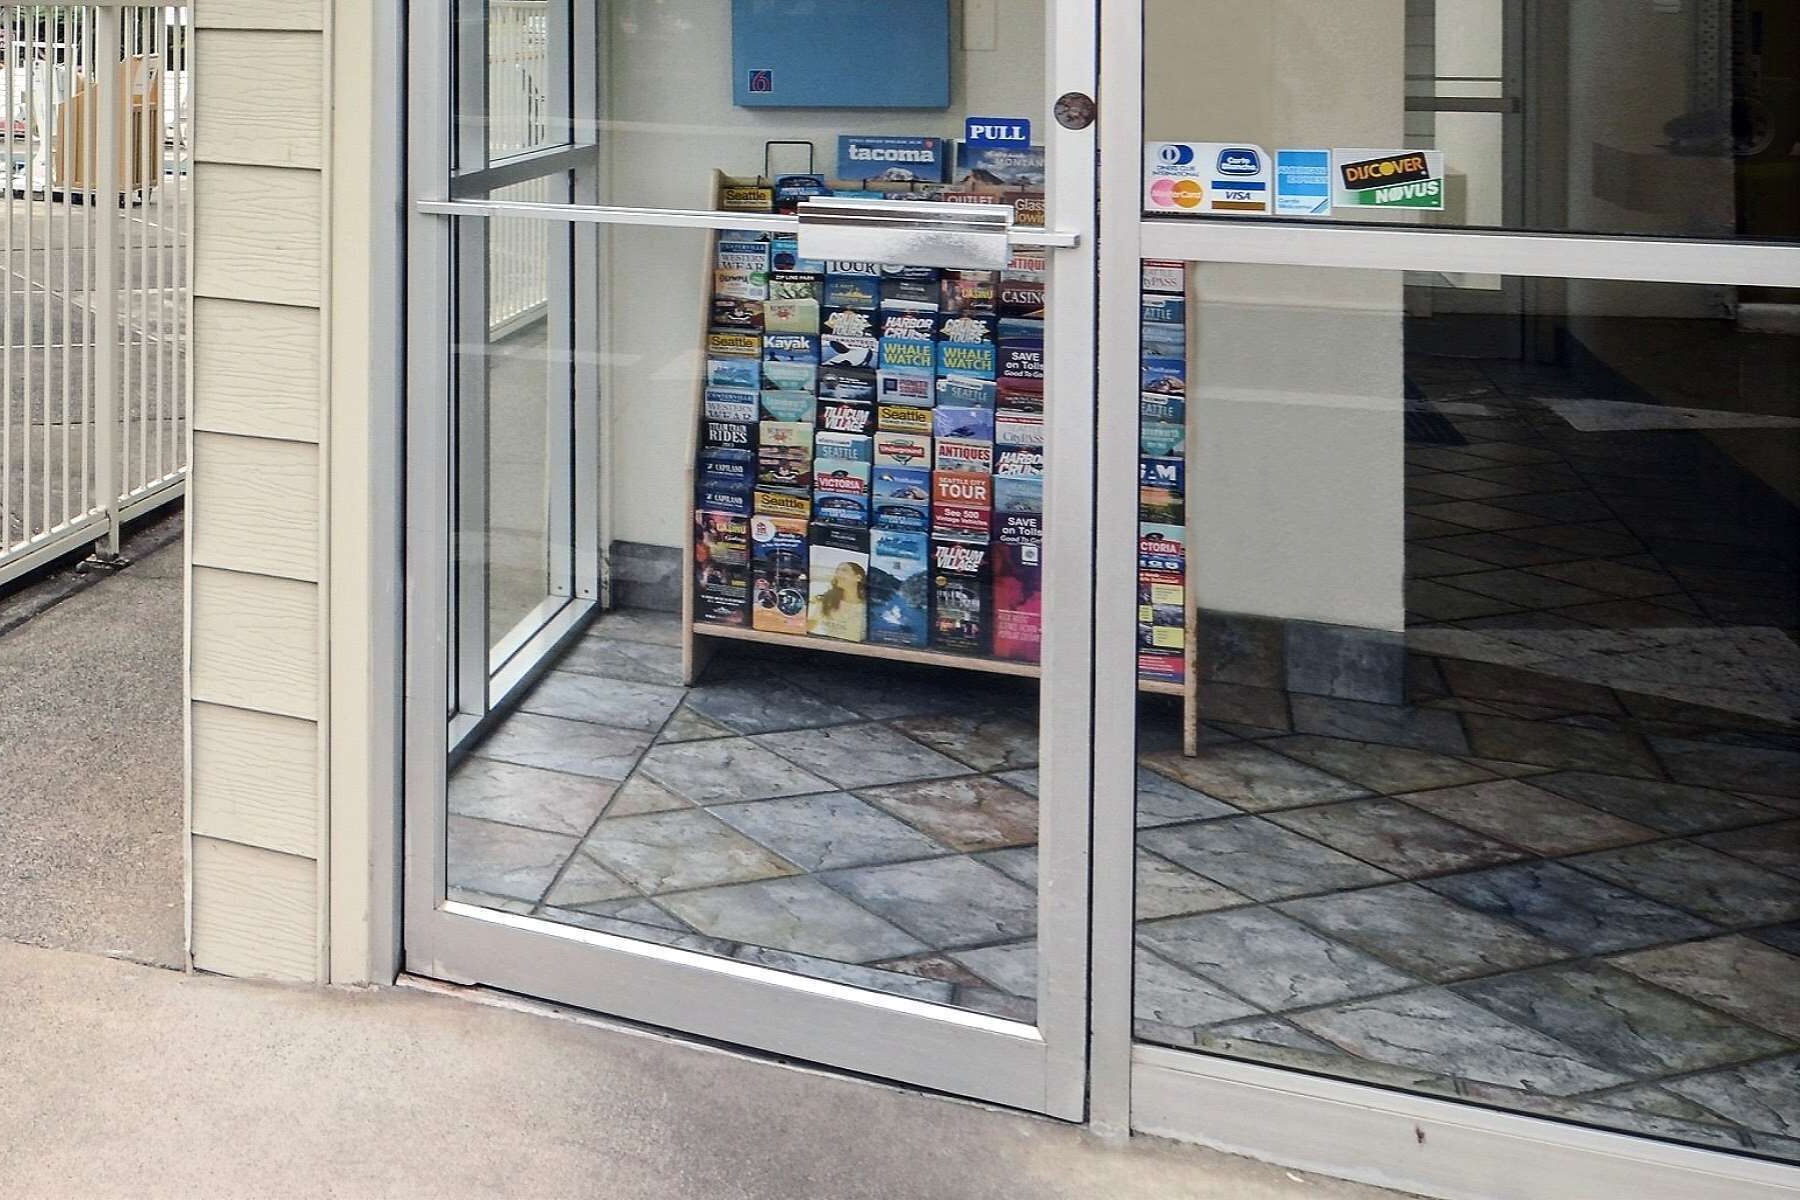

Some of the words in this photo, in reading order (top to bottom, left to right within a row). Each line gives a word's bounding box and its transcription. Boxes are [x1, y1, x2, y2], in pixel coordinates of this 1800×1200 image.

[969, 125, 1026, 141] PULL
[849, 144, 935, 162] tacoma
[997, 157, 1044, 168] MONTAN
[1345, 157, 1424, 182] DISCOVER
[1278, 166, 1328, 175] AMERICAN
[726, 189, 767, 200] Seattle
[1225, 191, 1251, 200] VISA
[1375, 181, 1439, 204] NOVUS
[832, 261, 877, 275] TOUR
[1143, 306, 1172, 321] ATTLE
[885, 316, 934, 328] HARBOR
[711, 336, 754, 347] Seattle
[763, 336, 810, 350] Kayak
[883, 343, 932, 356] WHALE
[943, 347, 992, 360] WHALE
[1011, 351, 1040, 361] SAVE
[884, 353, 931, 367] WATCH
[944, 358, 992, 371] WATCH
[951, 386, 987, 401] SEATTLE
[823, 406, 870, 422] TILLICUM
[881, 408, 926, 422] Seattle
[1142, 402, 1173, 417] EATTLE
[825, 415, 865, 432] VILLAGE
[709, 430, 748, 443] RIDES
[822, 445, 859, 460] SEATTLE
[938, 445, 990, 461] ANTIQUES
[1000, 451, 1043, 465] HARBO
[999, 463, 1043, 476] CRUIS
[819, 477, 861, 490] VICTORIA
[939, 484, 987, 501] TOUR
[761, 494, 805, 510] Seattle
[944, 508, 962, 517] See
[1007, 517, 1038, 527] SAVE
[1002, 527, 1016, 535] on
[1141, 541, 1177, 553] CTORIA
[935, 546, 985, 564] TILLICUM
[937, 556, 979, 572] VILLAGE
